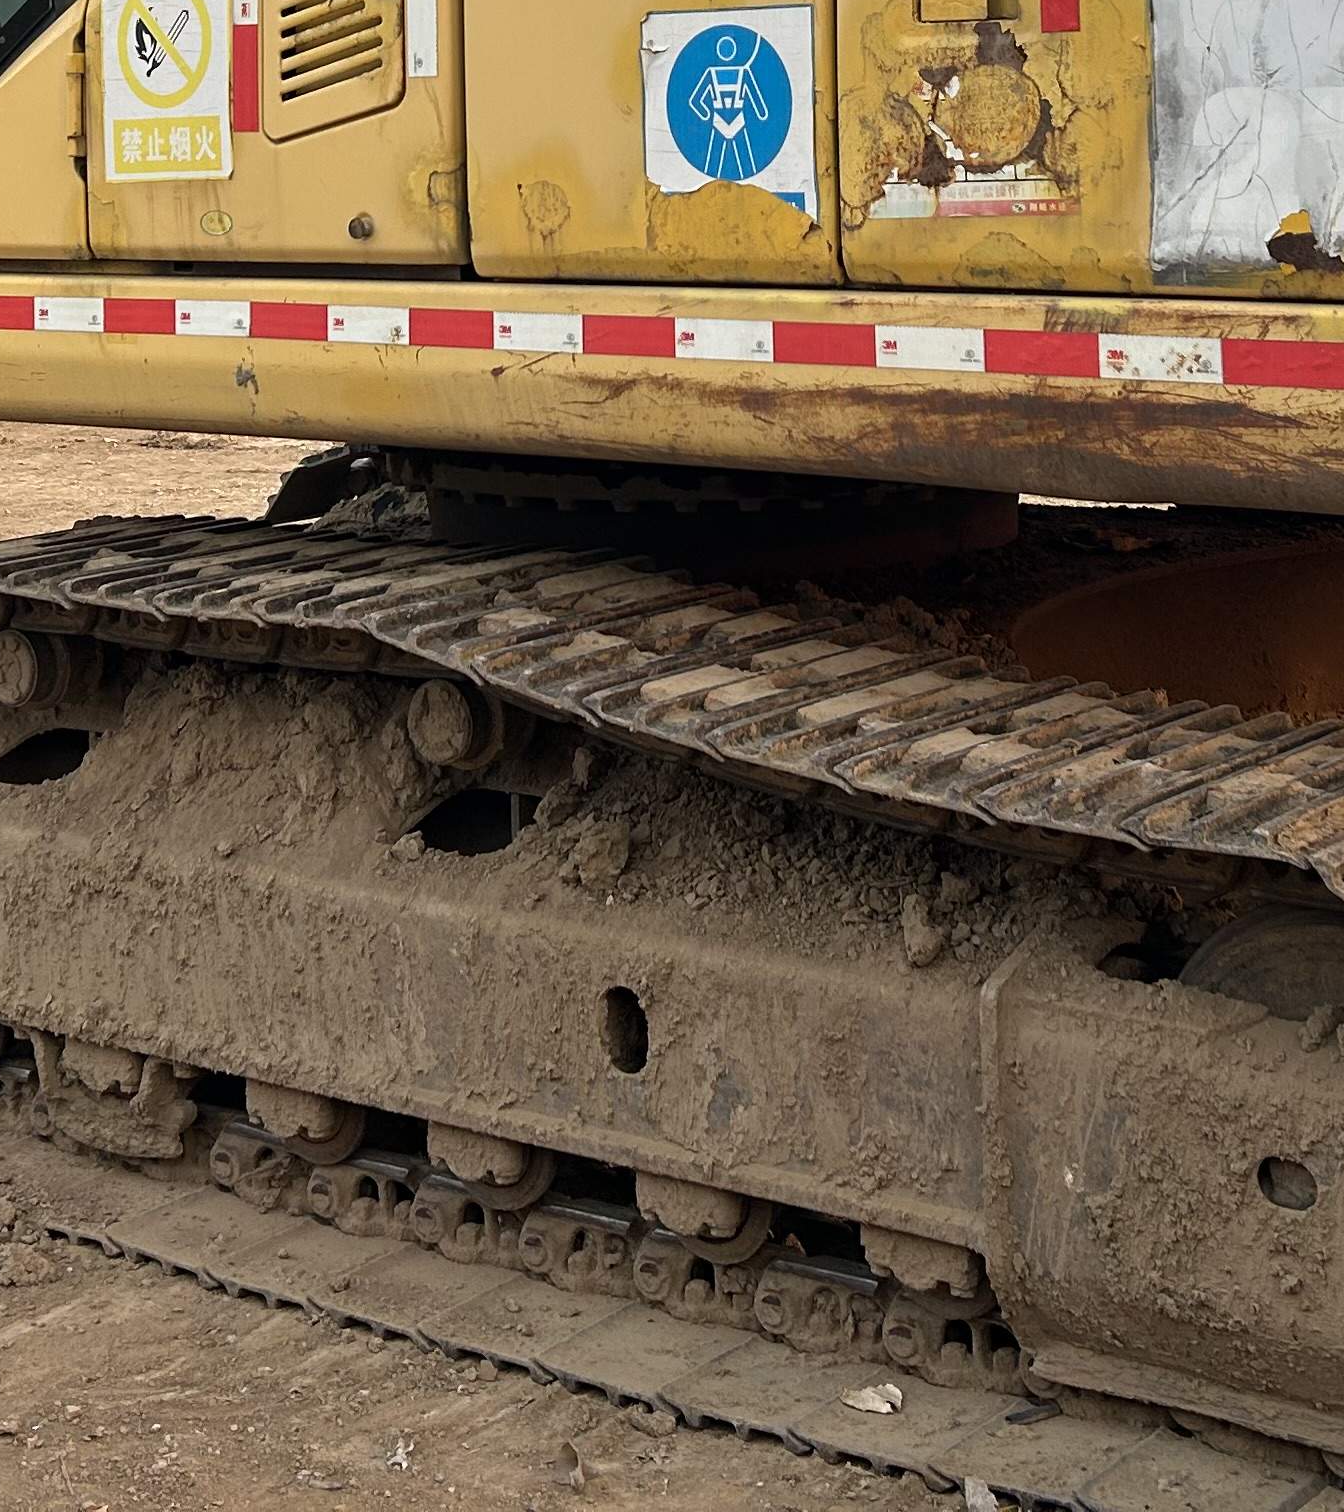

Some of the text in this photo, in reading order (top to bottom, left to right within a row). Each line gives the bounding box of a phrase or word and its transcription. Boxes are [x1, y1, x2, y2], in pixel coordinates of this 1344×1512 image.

[121, 127, 216, 165] 禁止烟火
[882, 340, 897, 350] 3M
[1107, 350, 1124, 360] 3M
